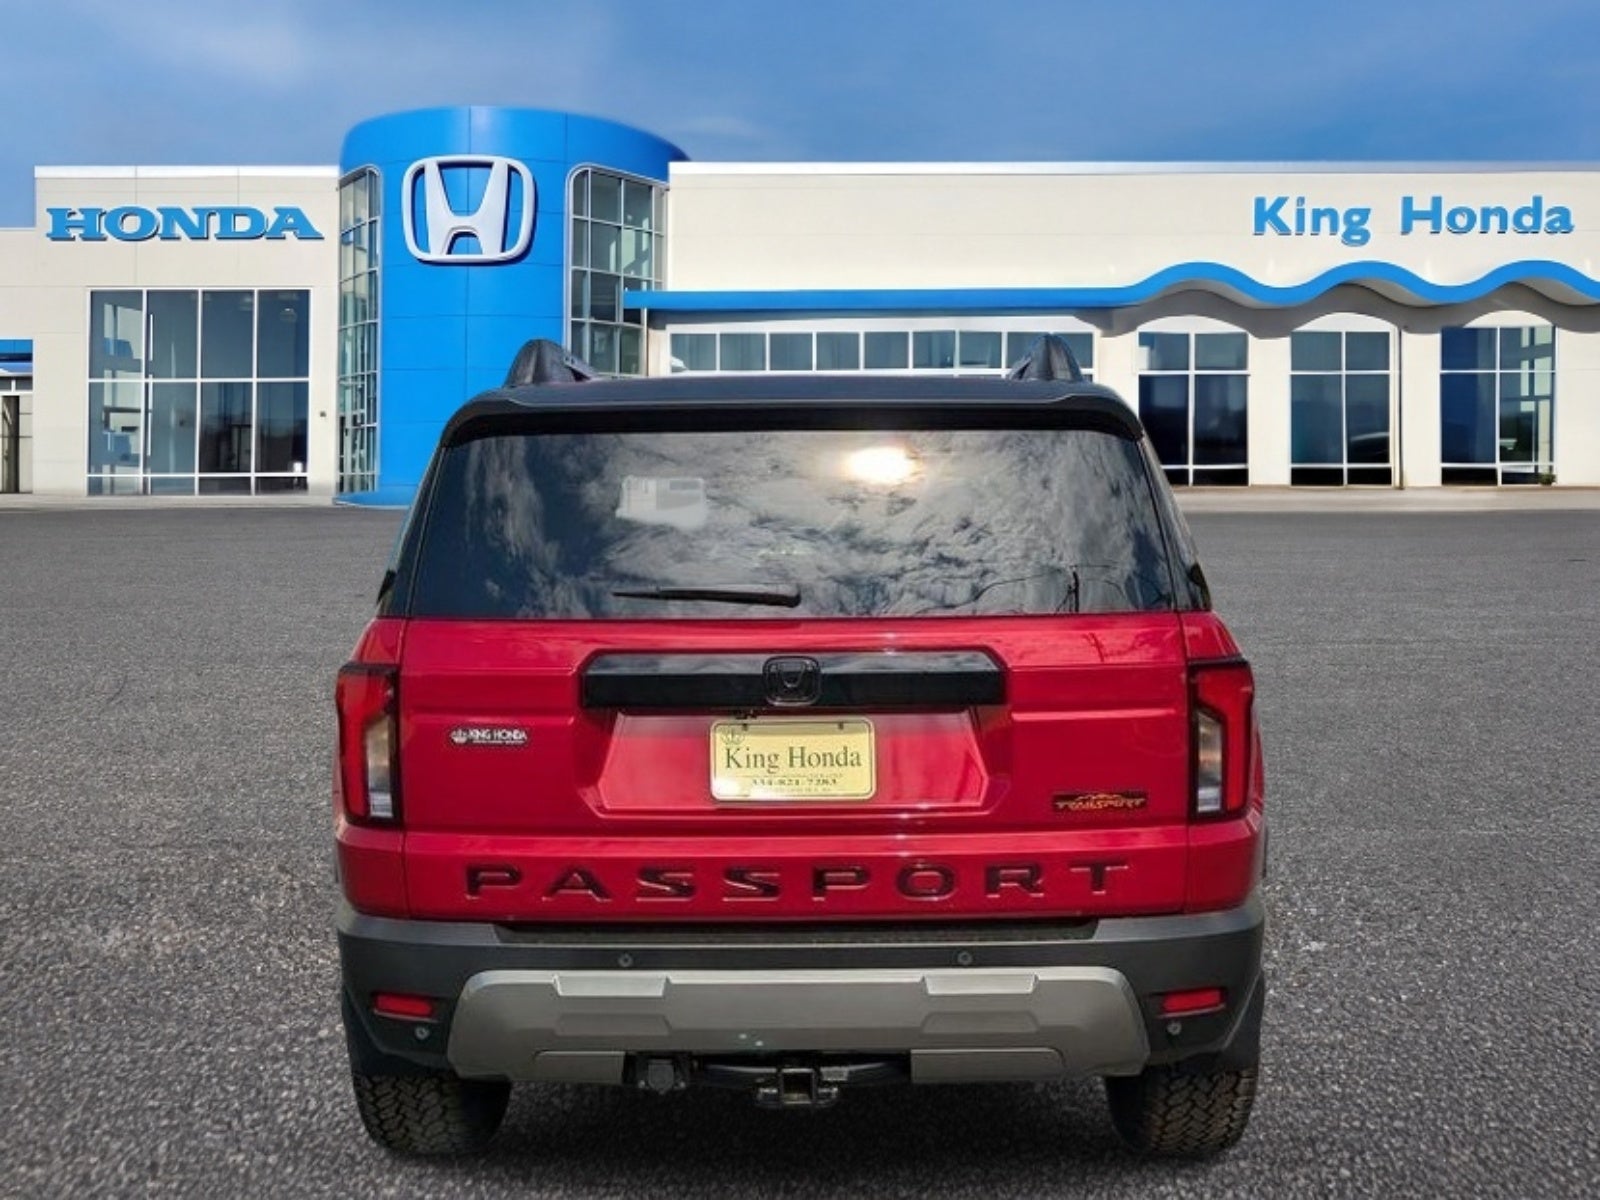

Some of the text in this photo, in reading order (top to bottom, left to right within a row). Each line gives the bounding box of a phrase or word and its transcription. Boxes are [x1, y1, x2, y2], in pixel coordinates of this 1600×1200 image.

[46, 206, 324, 242] HONDA
[1253, 195, 1574, 246] King Honda
[725, 746, 862, 773] King Honda
[464, 864, 1130, 903] PASSPORT
